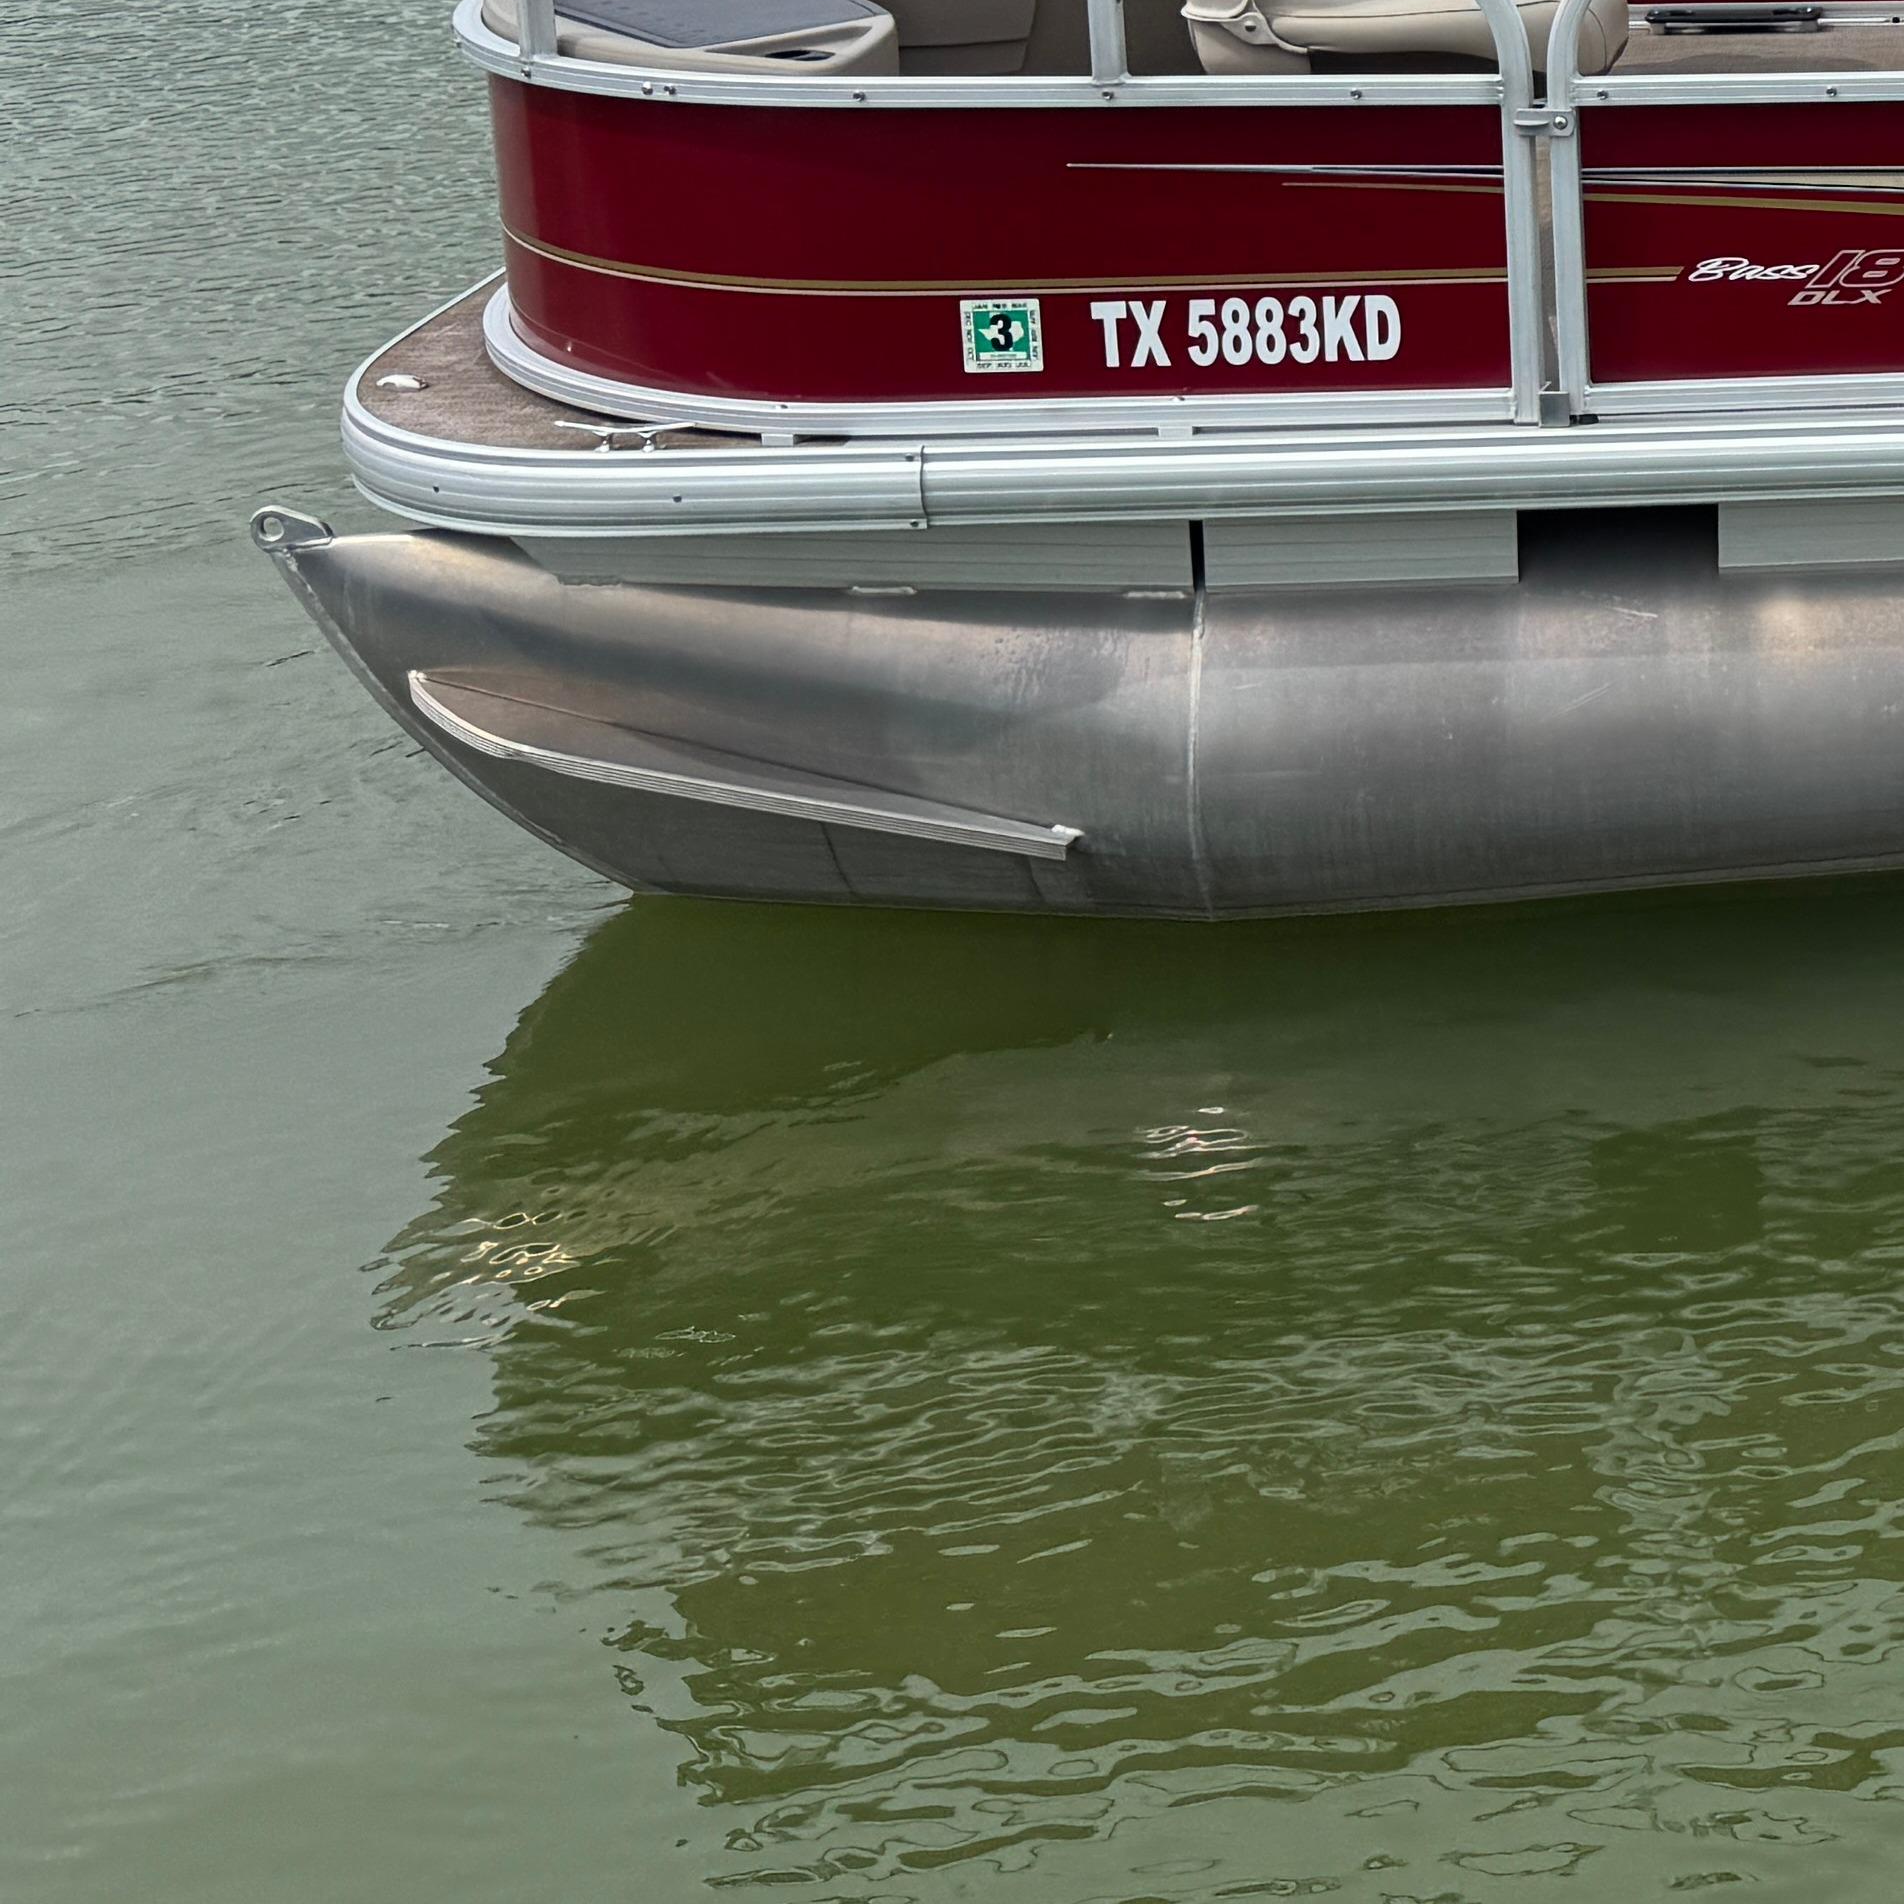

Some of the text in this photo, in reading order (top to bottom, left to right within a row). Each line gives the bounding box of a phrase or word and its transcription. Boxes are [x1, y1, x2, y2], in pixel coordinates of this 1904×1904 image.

[1688, 256, 1819, 282] Bass
[1787, 289, 1892, 306] DLX
[990, 313, 1014, 352] 3
[1090, 301, 1171, 368] TX
[1187, 295, 1402, 367] 5883KD
